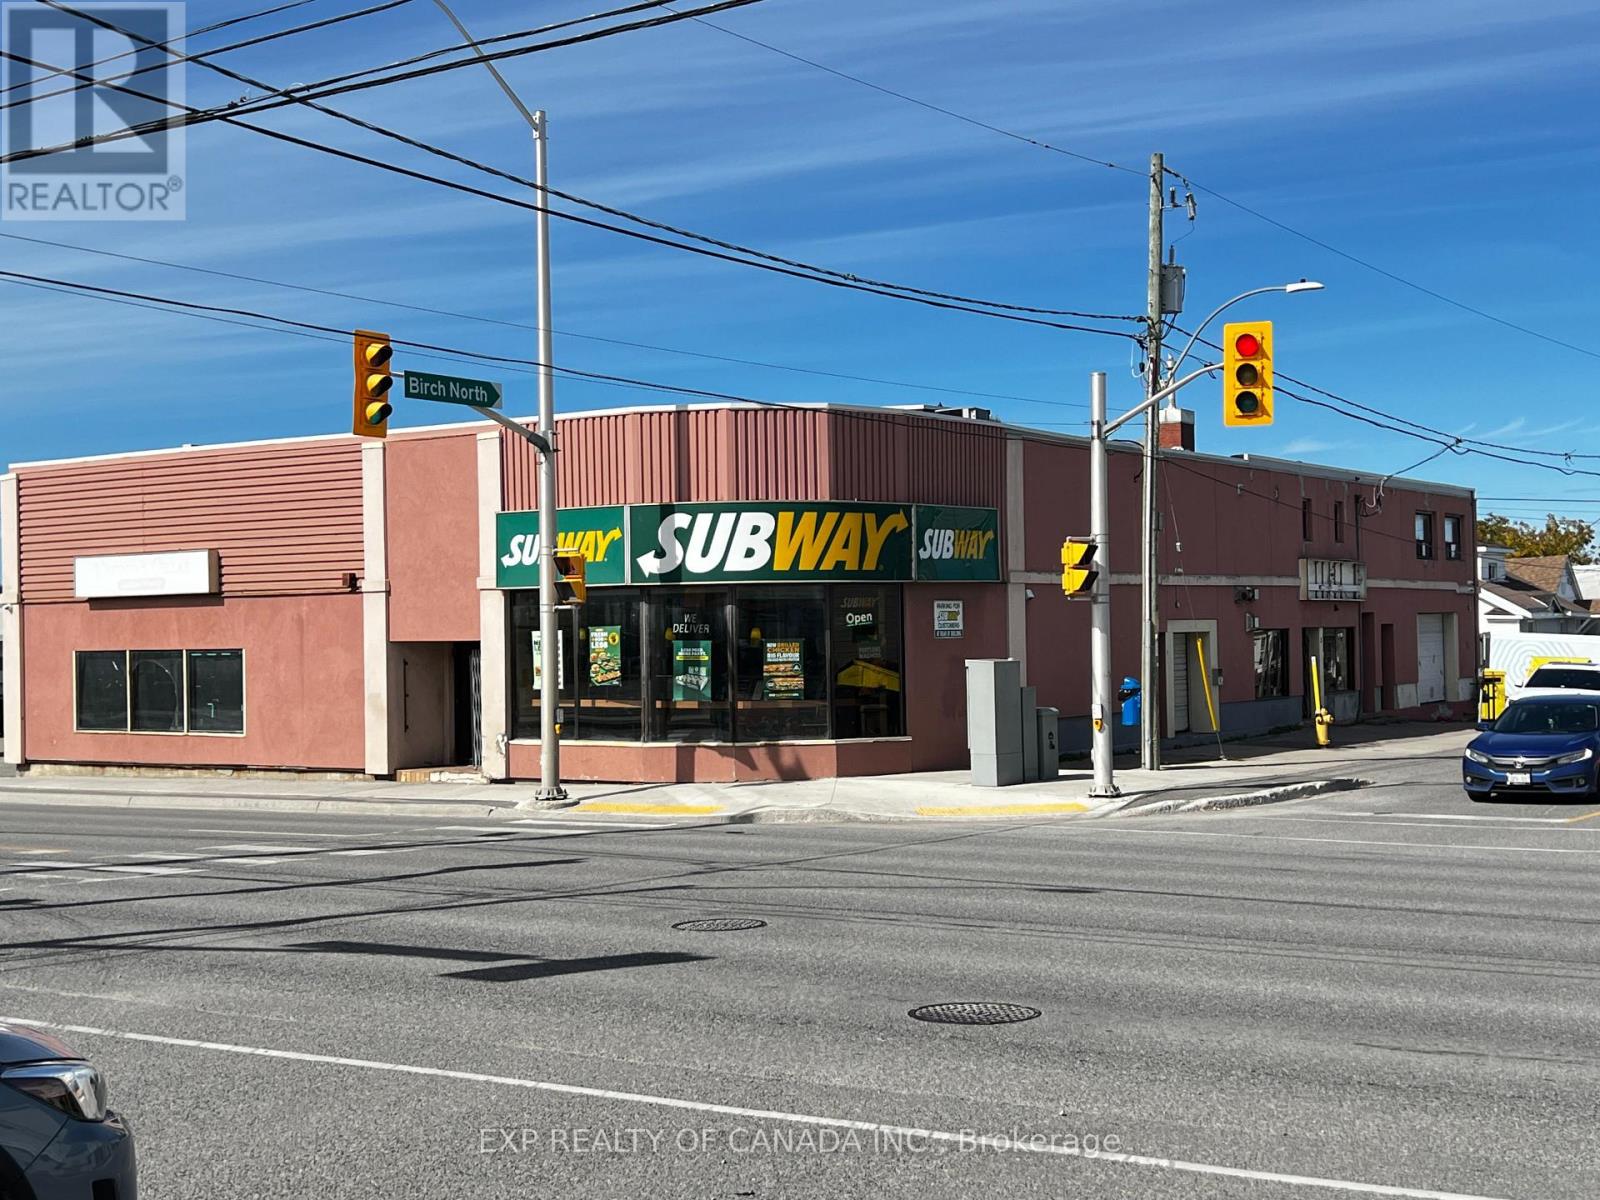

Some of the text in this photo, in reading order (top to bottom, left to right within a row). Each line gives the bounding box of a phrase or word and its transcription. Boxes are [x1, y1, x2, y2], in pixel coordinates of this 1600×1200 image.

[408, 376, 488, 402] Birch North
[501, 526, 623, 568] SUWAY
[636, 509, 909, 578] SUBWAY
[918, 526, 995, 561] SUBWAY
[672, 623, 710, 634] DELIVER
[684, 613, 697, 624] WE
[846, 612, 873, 626] Open
